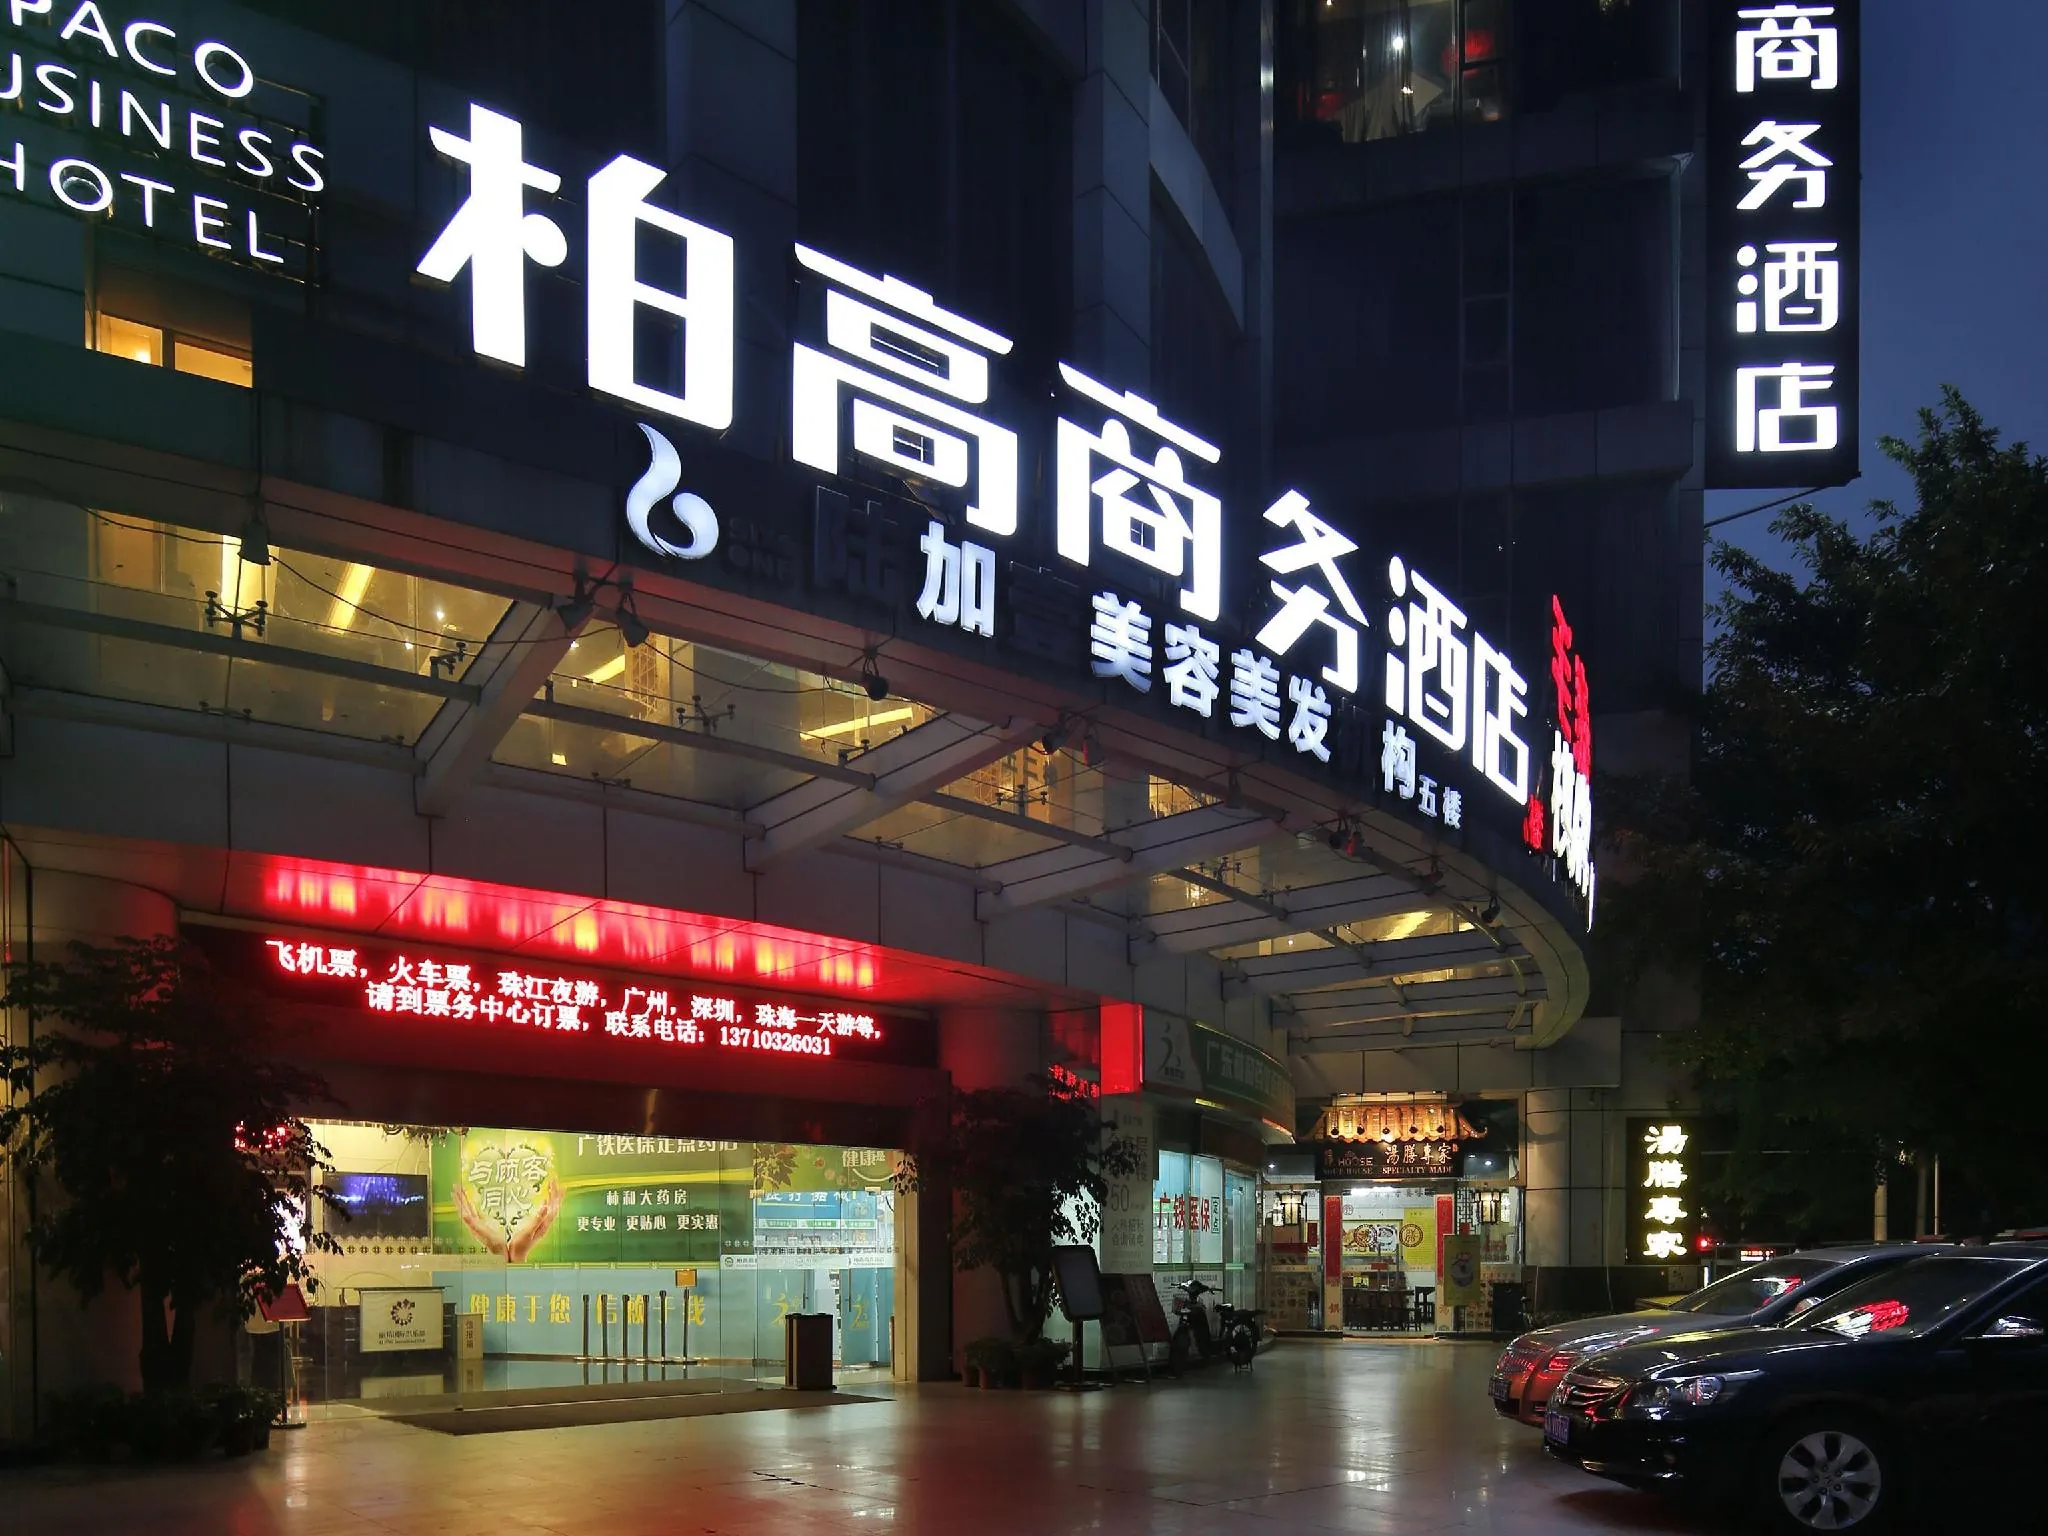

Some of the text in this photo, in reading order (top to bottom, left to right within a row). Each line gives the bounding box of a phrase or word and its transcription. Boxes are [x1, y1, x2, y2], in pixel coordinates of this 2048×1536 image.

[10, 0, 254, 98] PACO
[0, 142, 284, 264] HOTEL
[1736, 4, 1838, 453] 商务酒店
[416, 102, 1529, 806] 柏高商务酒店
[468, 1155, 548, 1184] 与顾客
[481, 1186, 532, 1211] 同心
